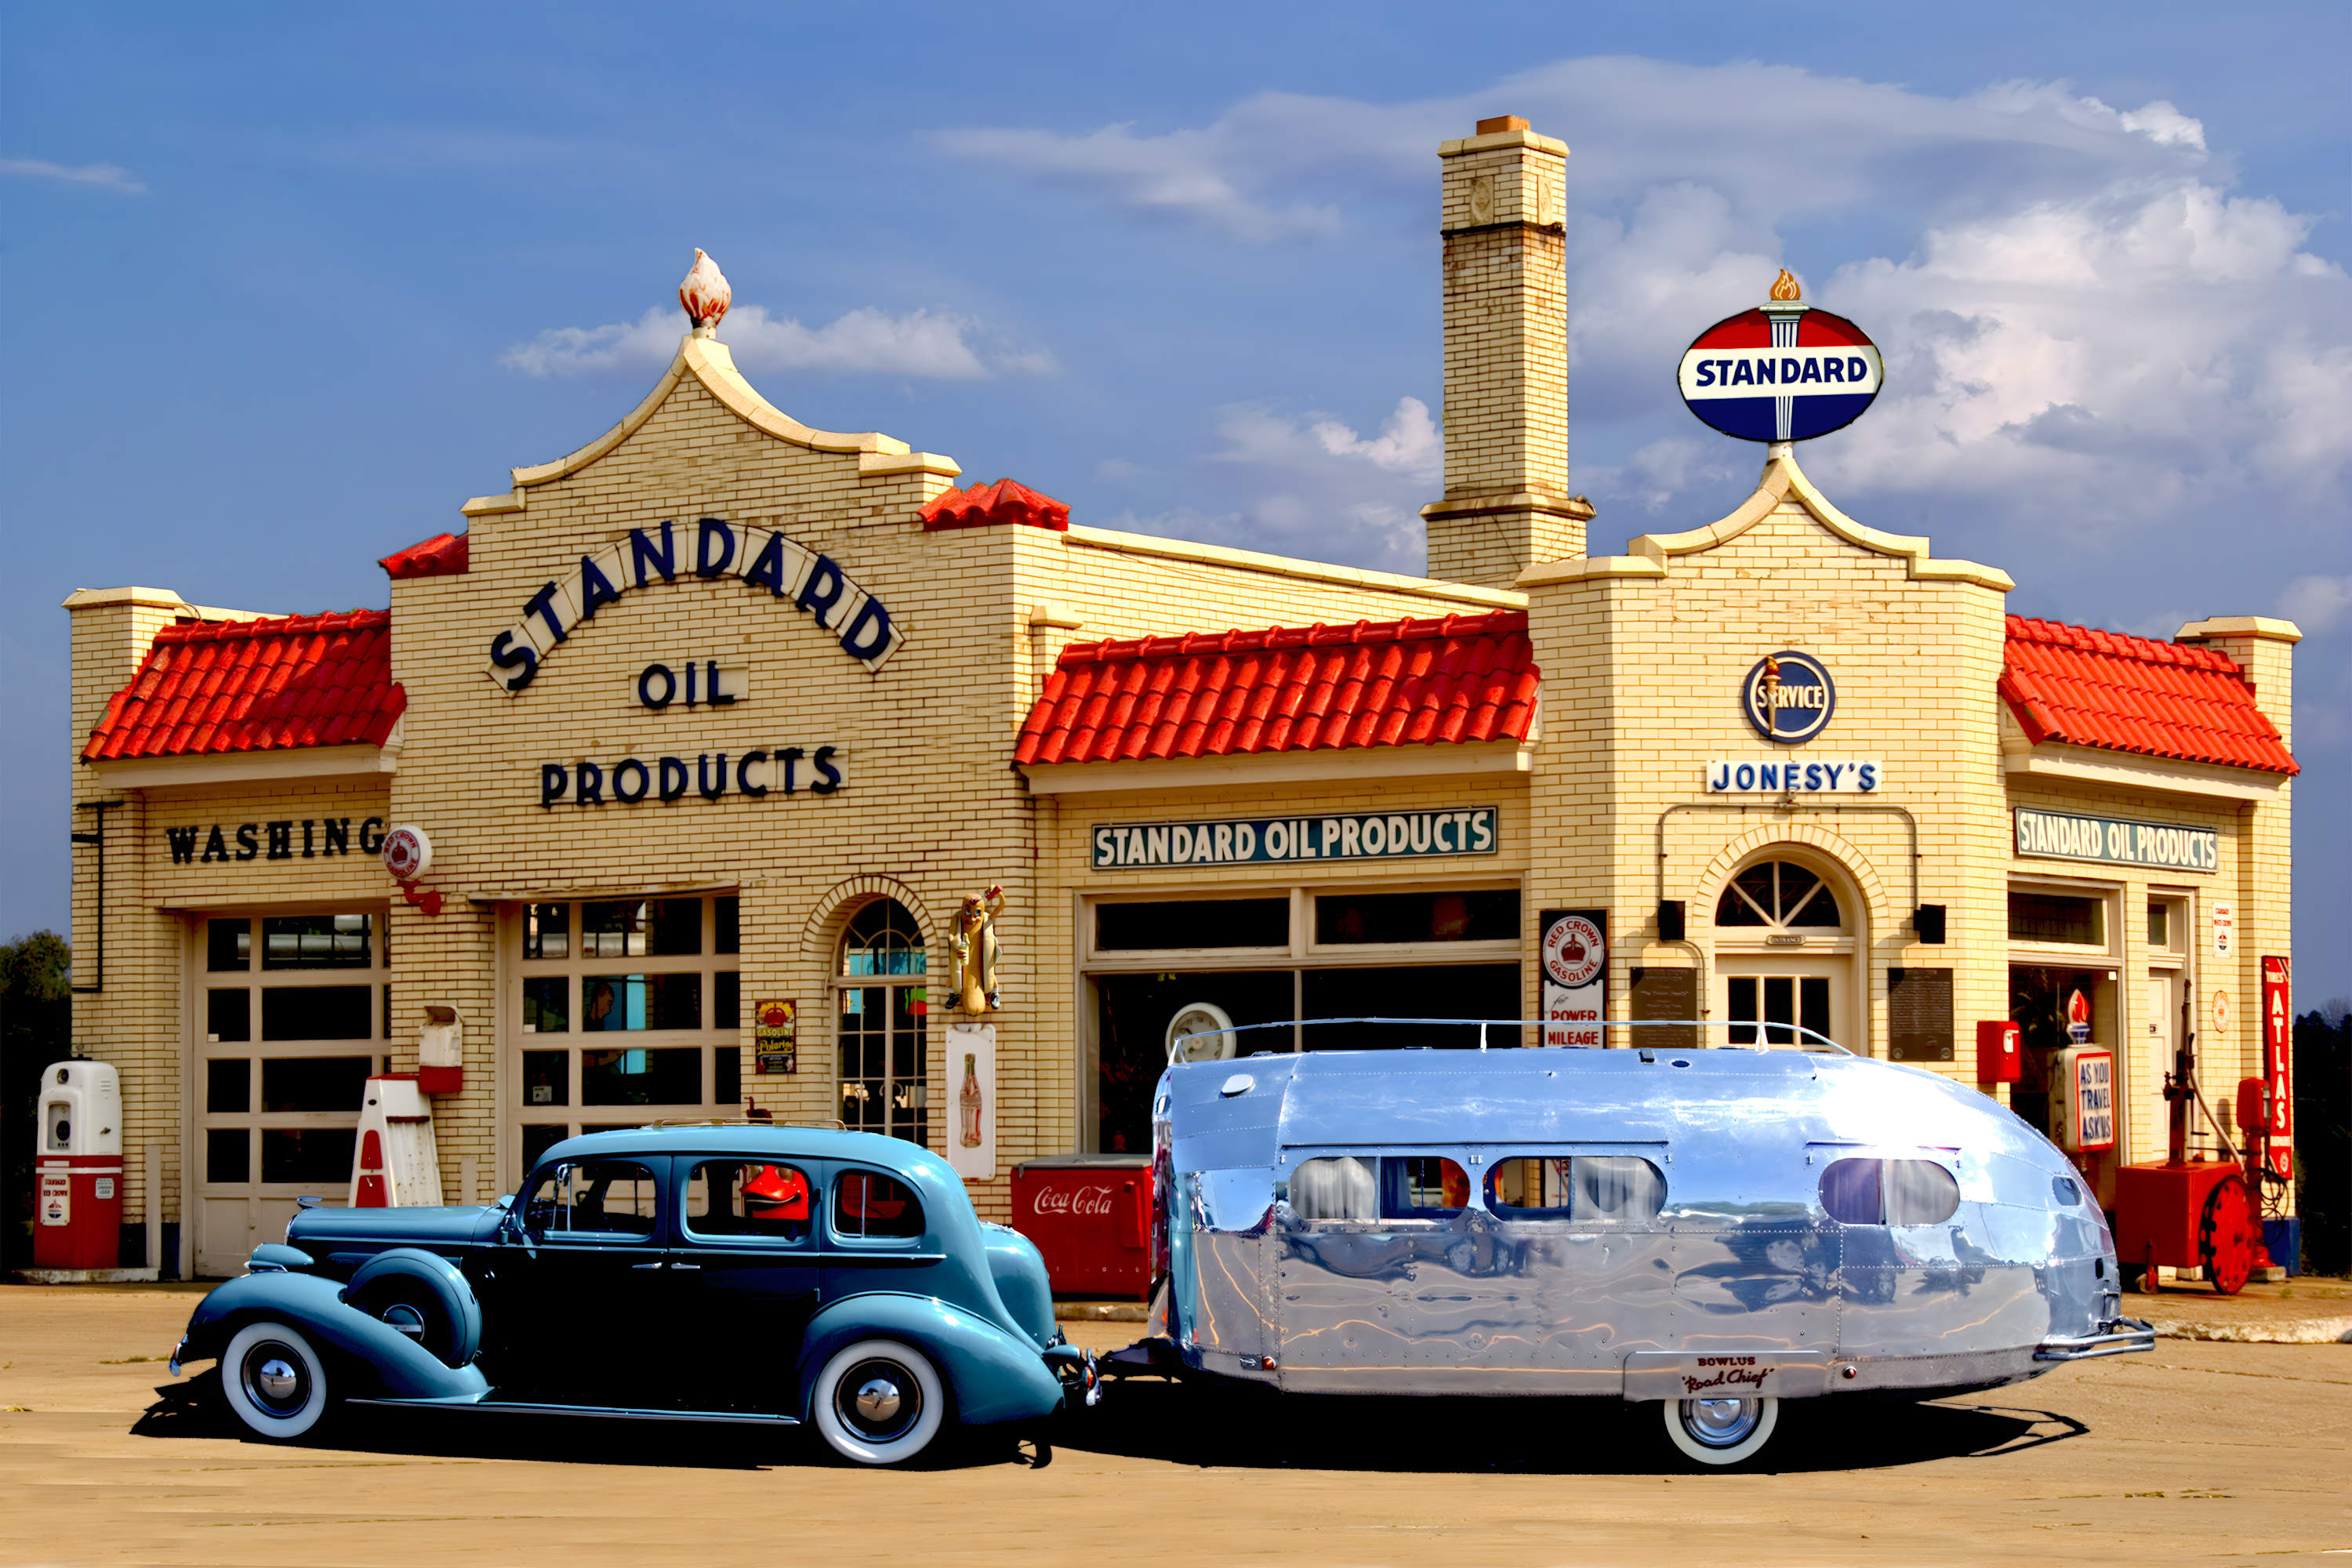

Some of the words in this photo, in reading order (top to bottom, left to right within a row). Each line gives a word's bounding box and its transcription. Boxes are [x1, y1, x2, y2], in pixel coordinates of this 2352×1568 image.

[1696, 357, 1867, 387] STANDARD
[491, 518, 892, 691] STANDARD
[638, 661, 735, 709] OIL
[541, 746, 841, 808] PRODUCTS
[1713, 763, 1876, 790] JONESY'S
[165, 817, 385, 864] WASHING
[394, 832, 416, 848] CROWN
[1097, 822, 1256, 866] STANDARD
[1265, 818, 1317, 859] OIL
[1322, 811, 1491, 857] PRODUCTS
[2020, 812, 2103, 858] STANDARD
[2107, 822, 2135, 861] OIL
[2136, 825, 2216, 869] PRODUCTS
[1548, 926, 1565, 949] RED
[1566, 920, 1599, 947] CROWN
[1549, 959, 1599, 982] GASOLINE
[1551, 1010, 1598, 1022] POWER
[1548, 1031, 1599, 1045] MILEAGE
[2080, 1063, 2092, 1084] AS
[2093, 1062, 2109, 1083] YOU
[2271, 989, 2286, 1129] ATLAS
[2081, 1088, 2111, 1110] TRAVEL
[2082, 1116, 2100, 1140] ASK
[1034, 1186, 1069, 1214] Coca
[1073, 1186, 1112, 1214] Cola
[1697, 1356, 1755, 1367] BOWLUS
